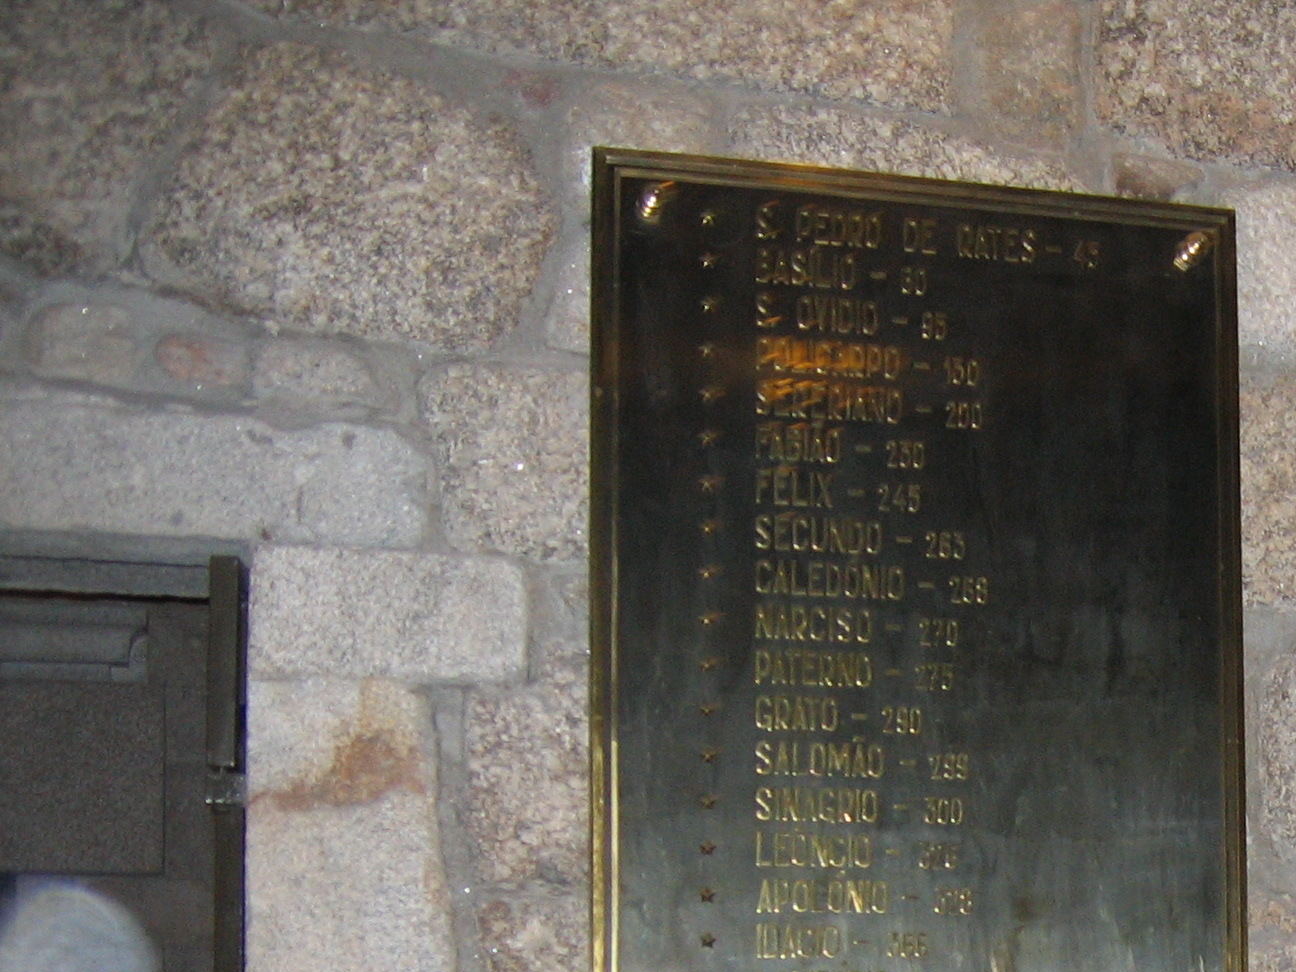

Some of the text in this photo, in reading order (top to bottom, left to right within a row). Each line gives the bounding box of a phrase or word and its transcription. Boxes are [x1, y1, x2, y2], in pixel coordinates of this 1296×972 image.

[796, 209, 883, 249] PEDRO
[904, 218, 937, 255] DE
[755, 512, 883, 555] SECUNDO
[755, 605, 872, 644] NARCISO
[755, 648, 872, 688] PATERNO
[755, 695, 838, 733] GRATO
